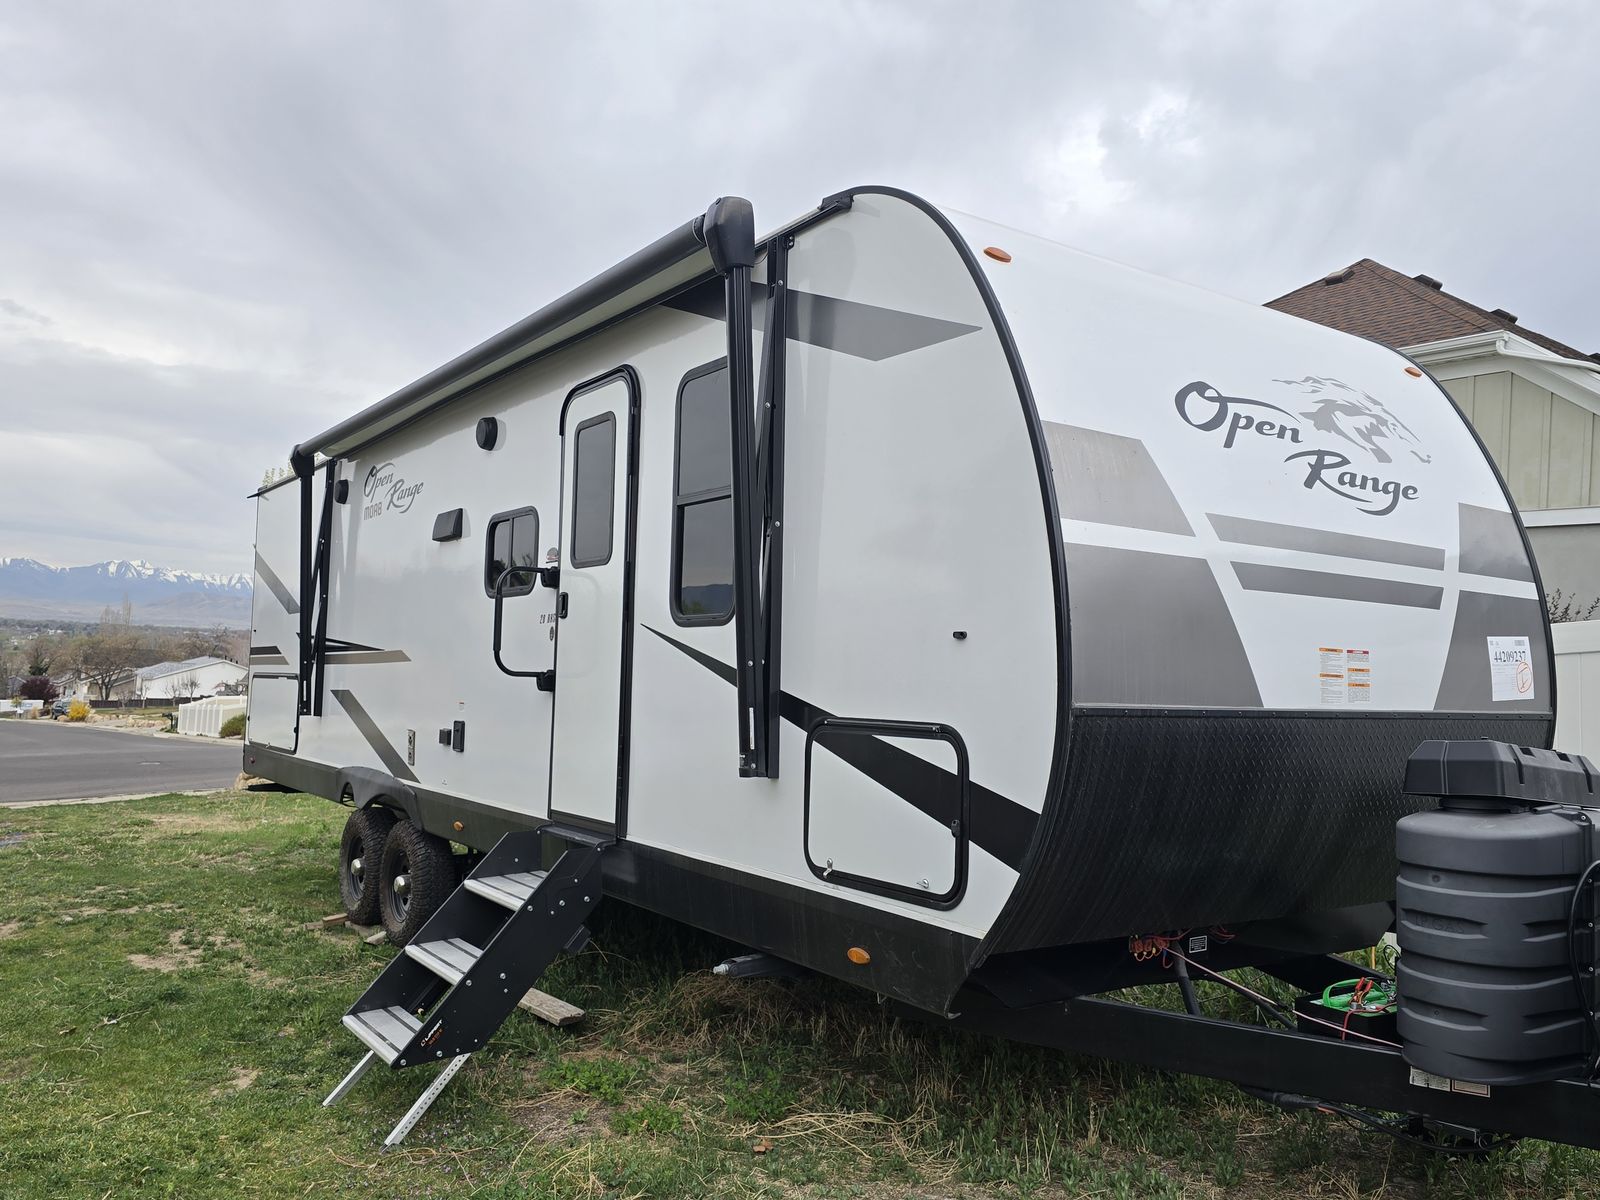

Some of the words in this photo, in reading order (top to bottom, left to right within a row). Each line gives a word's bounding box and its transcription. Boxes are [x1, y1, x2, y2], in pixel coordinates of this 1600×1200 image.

[1175, 381, 1303, 448] Open
[364, 463, 395, 503] Open
[384, 479, 424, 514] Range
[1284, 449, 1420, 516] Range
[364, 502, 382, 520] MOAB
[1494, 651, 1526, 662] 44209237
